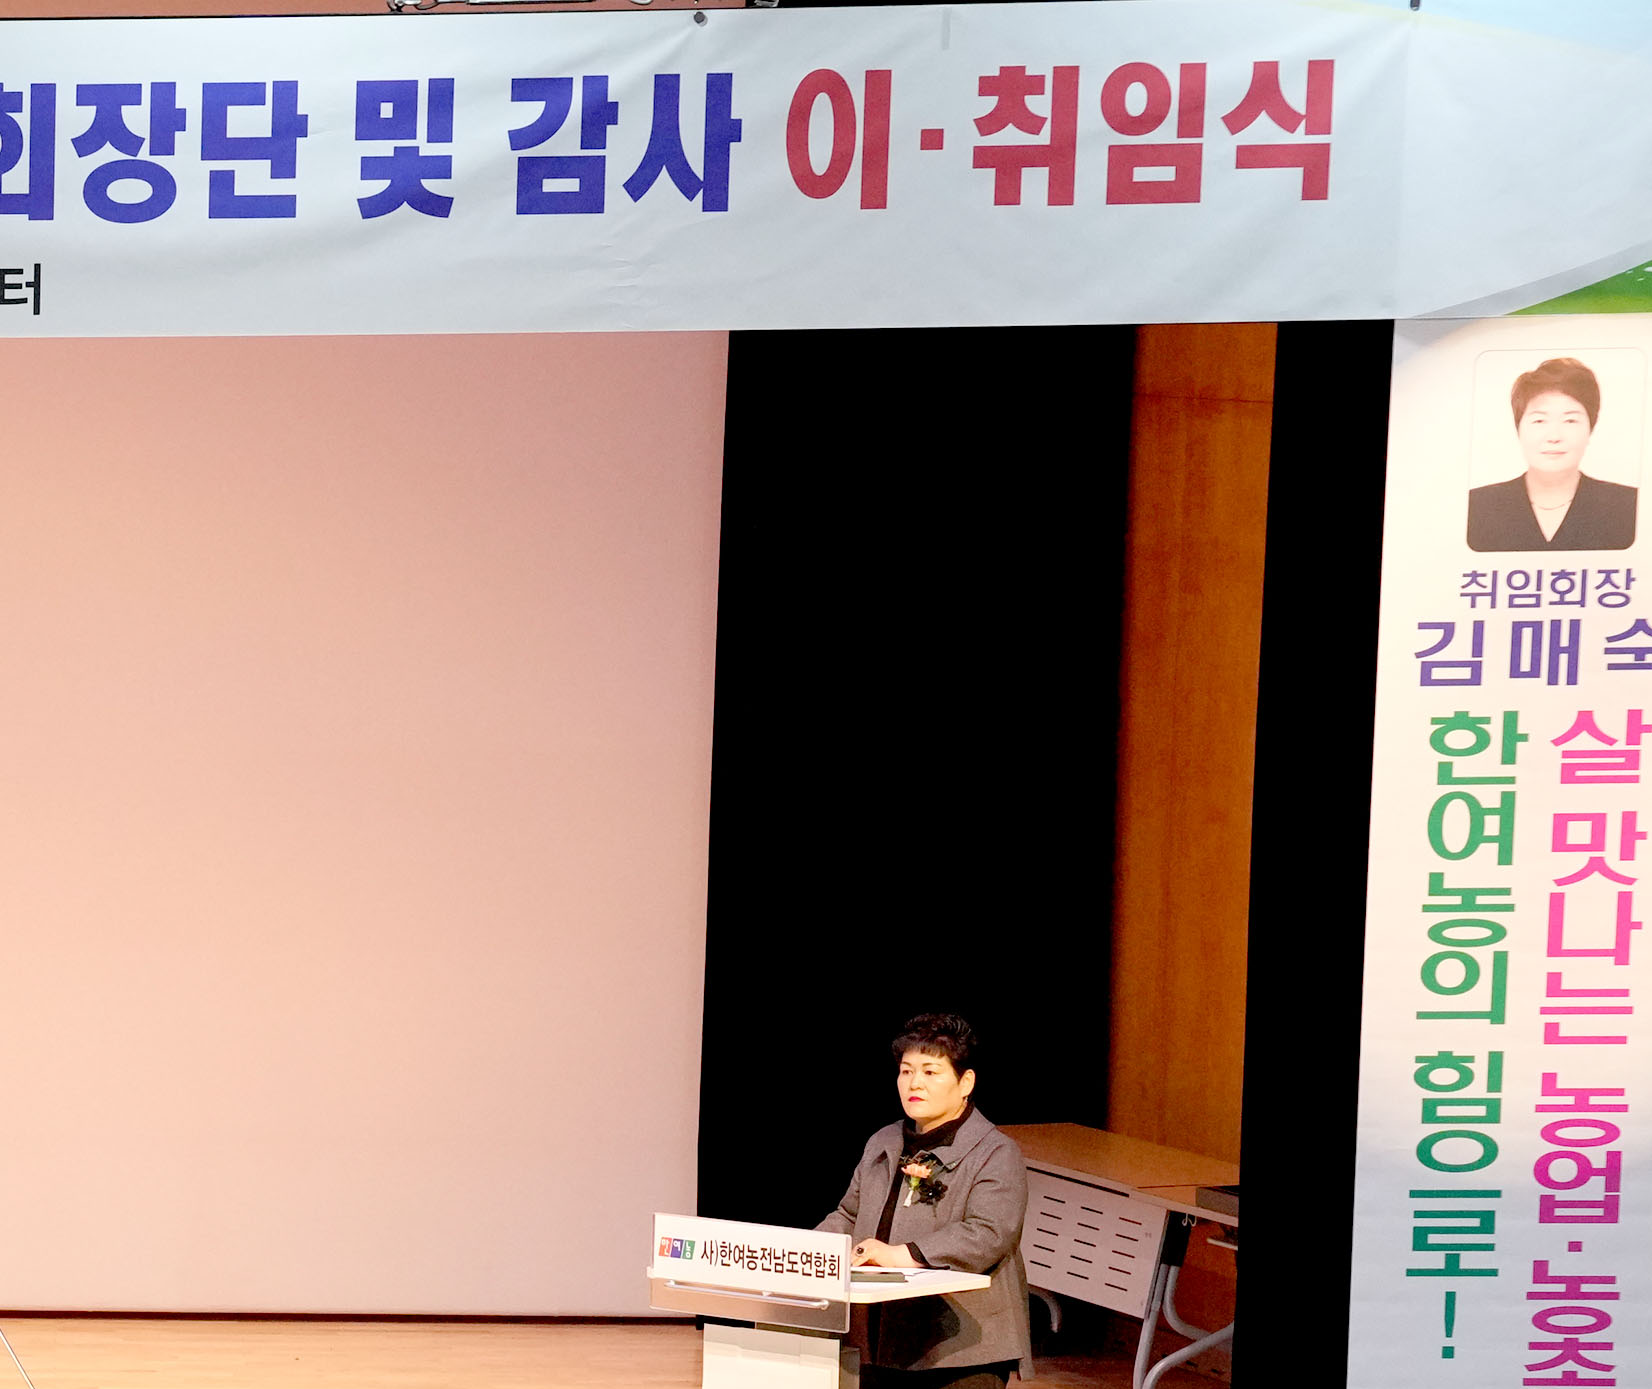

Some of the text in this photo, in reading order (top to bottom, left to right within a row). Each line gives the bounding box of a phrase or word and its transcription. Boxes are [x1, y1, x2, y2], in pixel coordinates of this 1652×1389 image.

[355, 77, 455, 220] 및
[508, 72, 742, 215] 감사
[786, 60, 1334, 210] 이·취임식
[1458, 567, 1636, 609] 취임회장
[1550, 709, 1652, 785] 살
[1539, 810, 1648, 1045] 맛나는
[1405, 710, 1529, 1360] 한여농의 힘으로!
